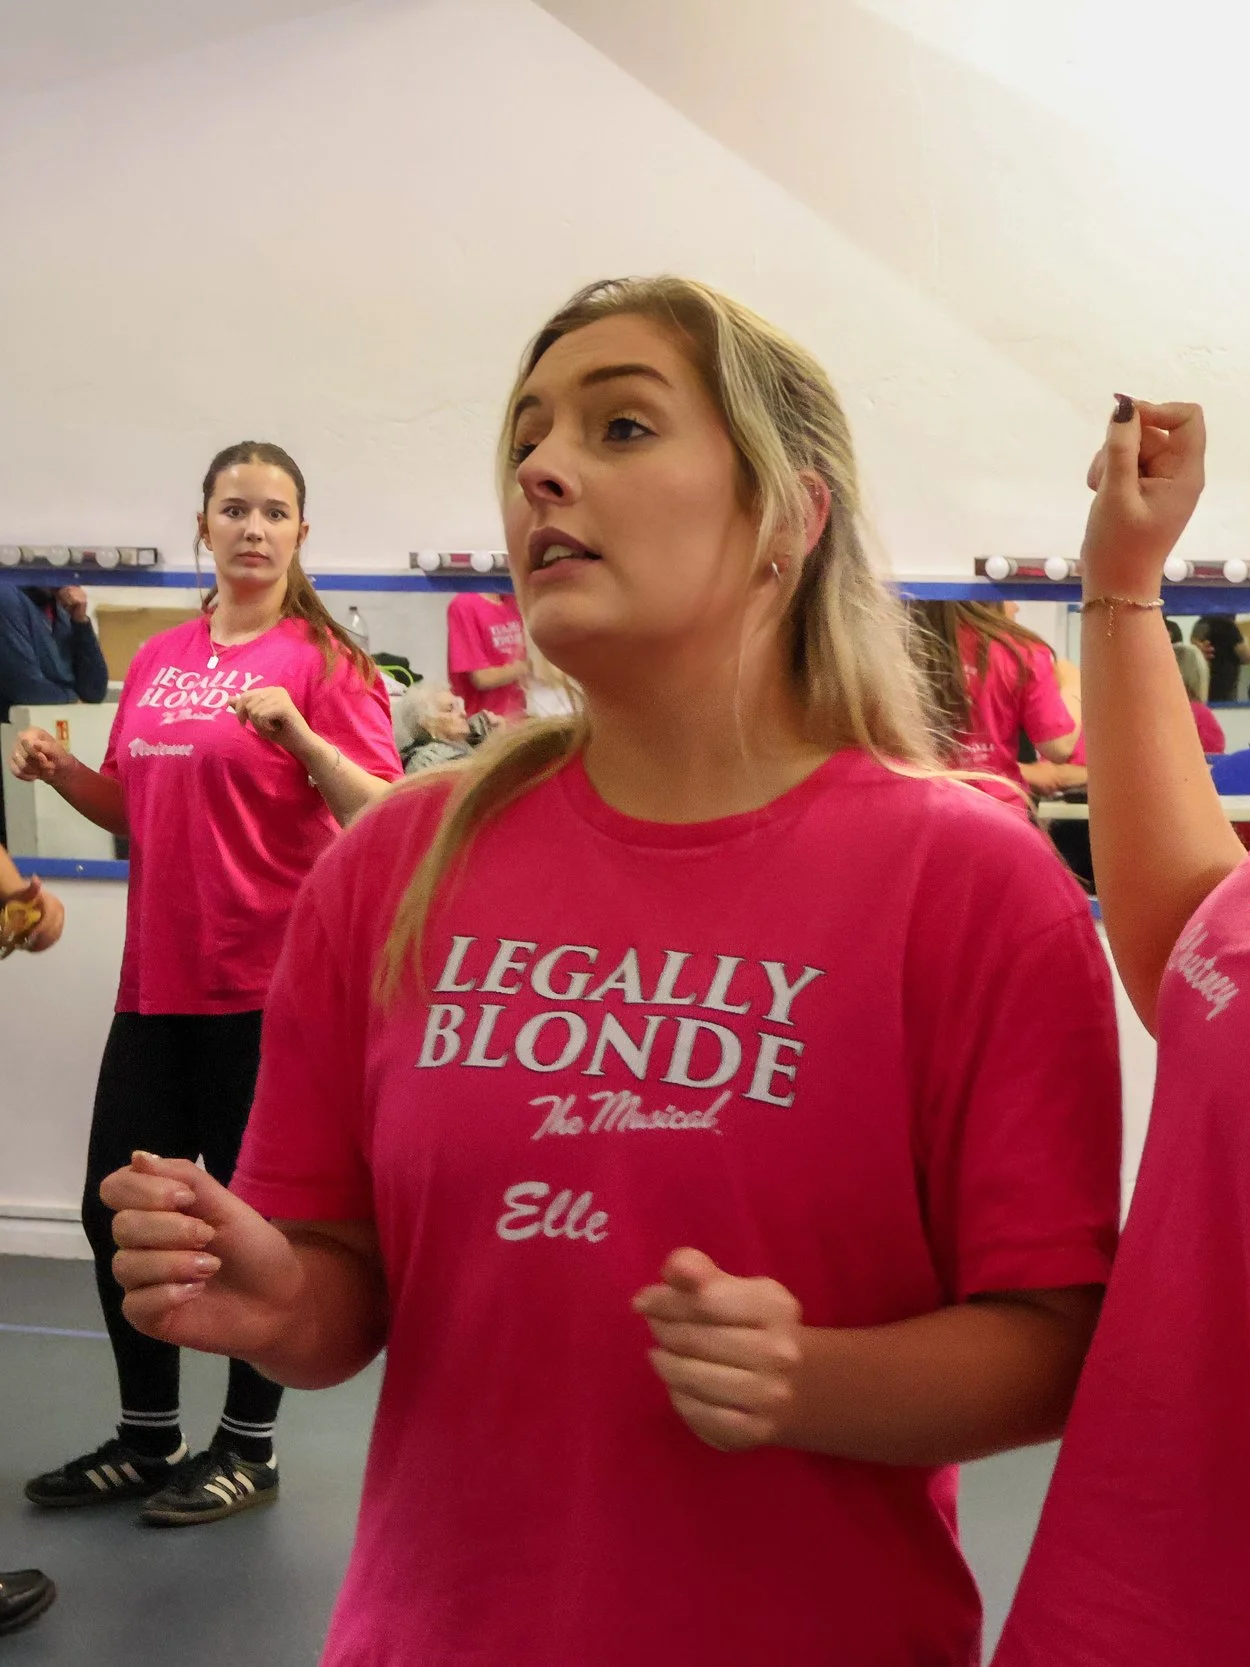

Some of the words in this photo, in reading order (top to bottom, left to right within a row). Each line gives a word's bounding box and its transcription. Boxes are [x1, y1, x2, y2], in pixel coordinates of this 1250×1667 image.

[136, 687, 242, 715] BLOND
[432, 935, 827, 1027] LEGALLY
[414, 1003, 806, 1108] BLONDE
[528, 1094, 585, 1142] The
[585, 1088, 734, 1137] Musical
[495, 1180, 610, 1244] Elle
